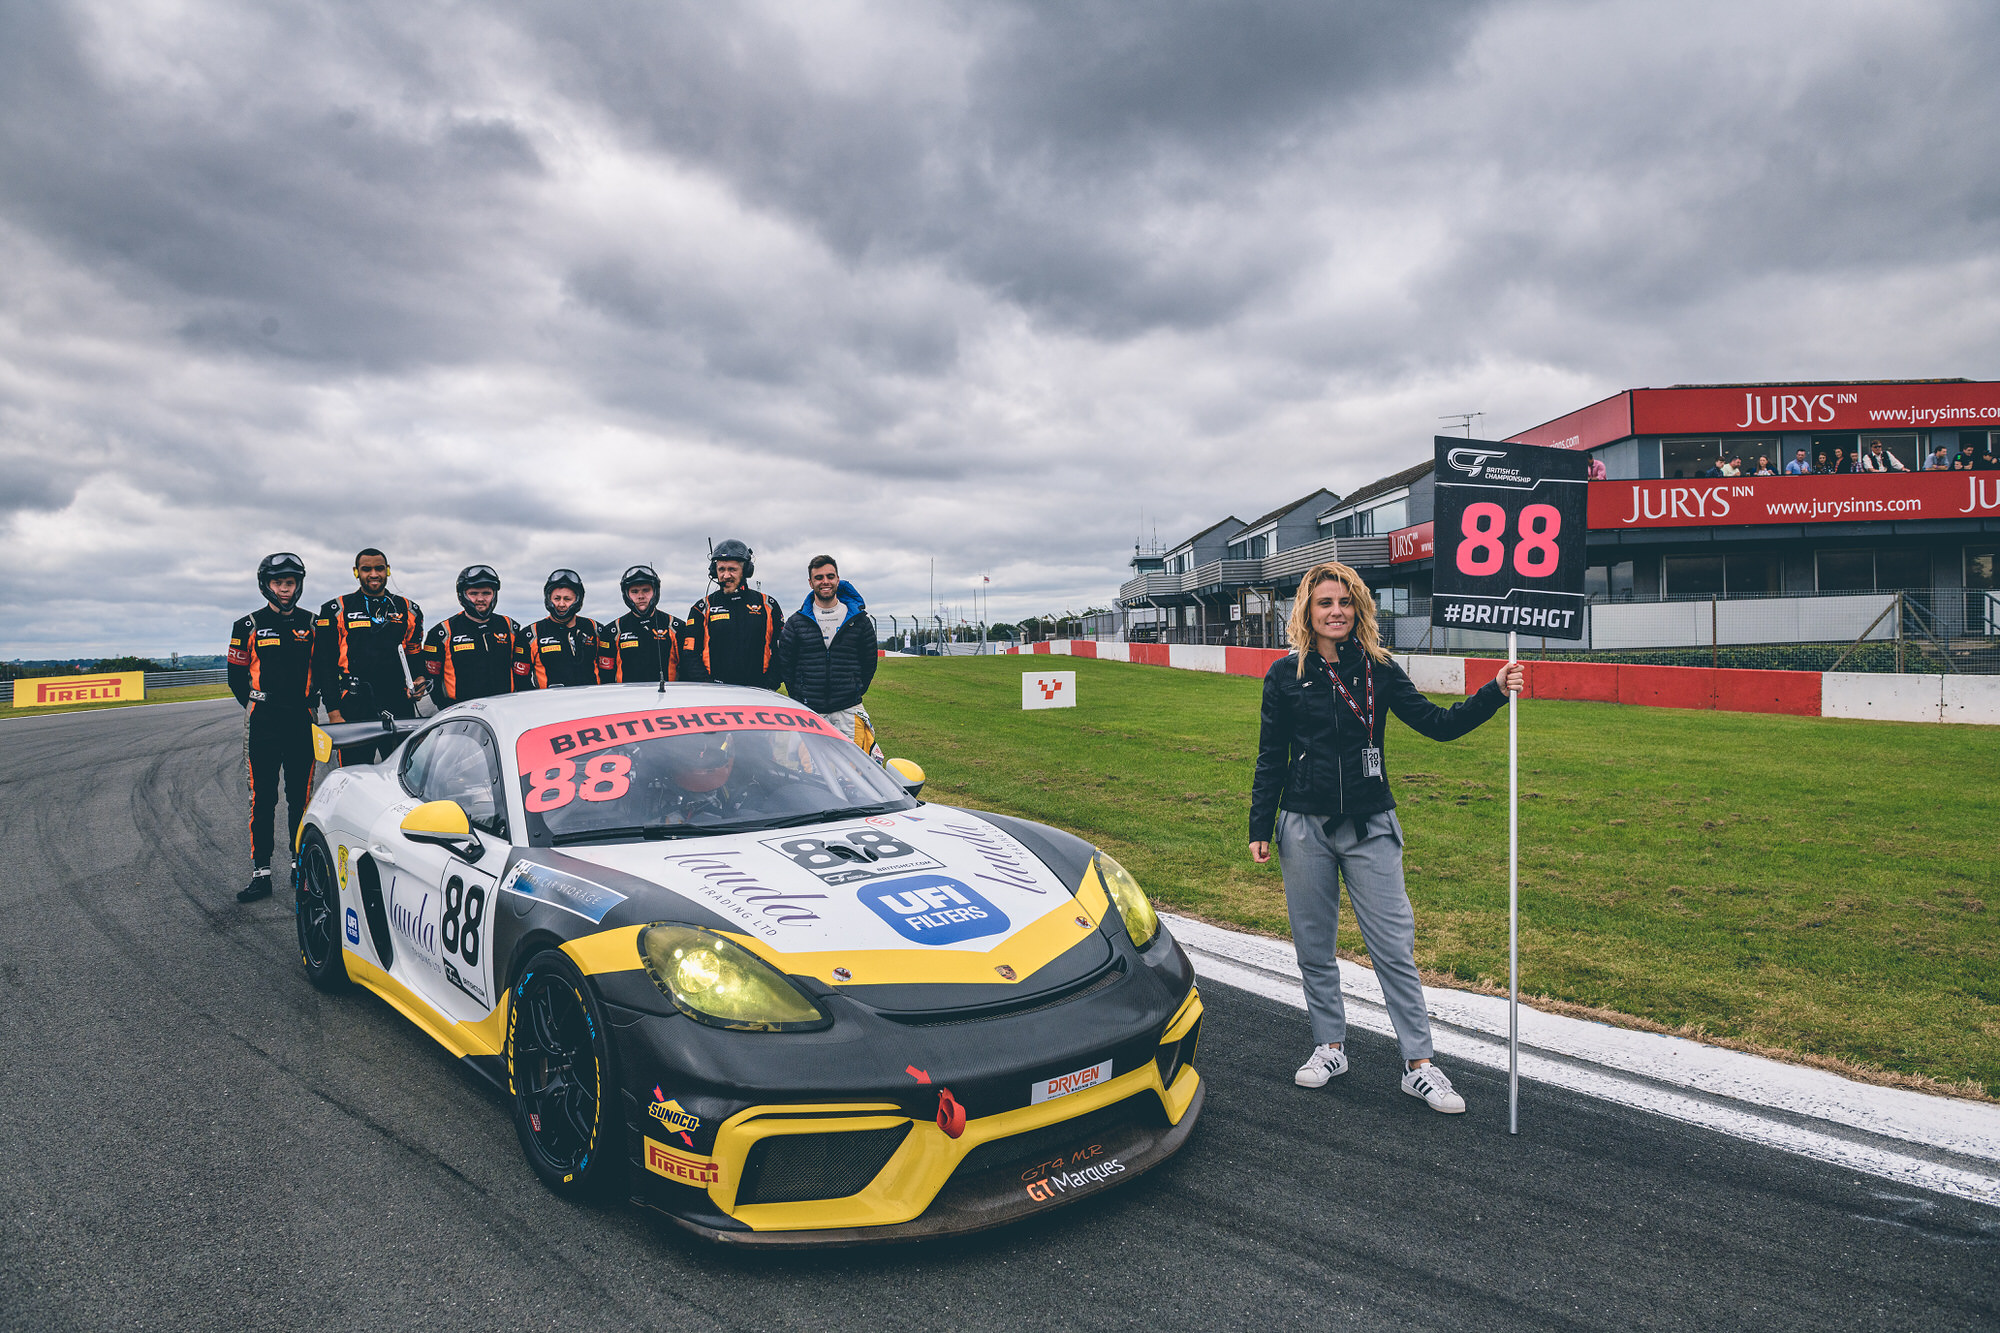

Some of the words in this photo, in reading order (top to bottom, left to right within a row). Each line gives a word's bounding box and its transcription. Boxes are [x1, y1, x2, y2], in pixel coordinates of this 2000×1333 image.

[1737, 393, 1835, 428] JURYS
[1837, 393, 1858, 404] INN
[1485, 472, 1532, 483] CHAMPIONSHIP
[1486, 466, 1511, 475] BRITISH
[1622, 486, 1730, 523] JURYS
[1732, 485, 1754, 497] INN
[1766, 497, 1921, 518] www.jurysinns.com
[1391, 533, 1414, 561] JURYS
[1456, 502, 1562, 578] 88
[1444, 603, 1575, 629] #BRITISHGT
[37, 678, 122, 703] PIRELLI
[550, 711, 823, 754] BRITISHGT.COM
[1368, 752, 1379, 760] 20
[1370, 760, 1379, 768] 19
[525, 754, 632, 813] 88
[781, 831, 915, 870] 88
[877, 860, 933, 872] BRITISHGT.COM
[557, 883, 602, 905] STORAGE
[878, 885, 971, 915] UFI
[442, 874, 485, 968] 88
[699, 883, 753, 920] TRADING
[753, 919, 777, 936] LTD
[905, 905, 989, 931] FILTERS
[1048, 1066, 1099, 1095] DRIVEN
[649, 1103, 698, 1130] SUNOCO
[649, 1145, 719, 1184] PIRELLI
